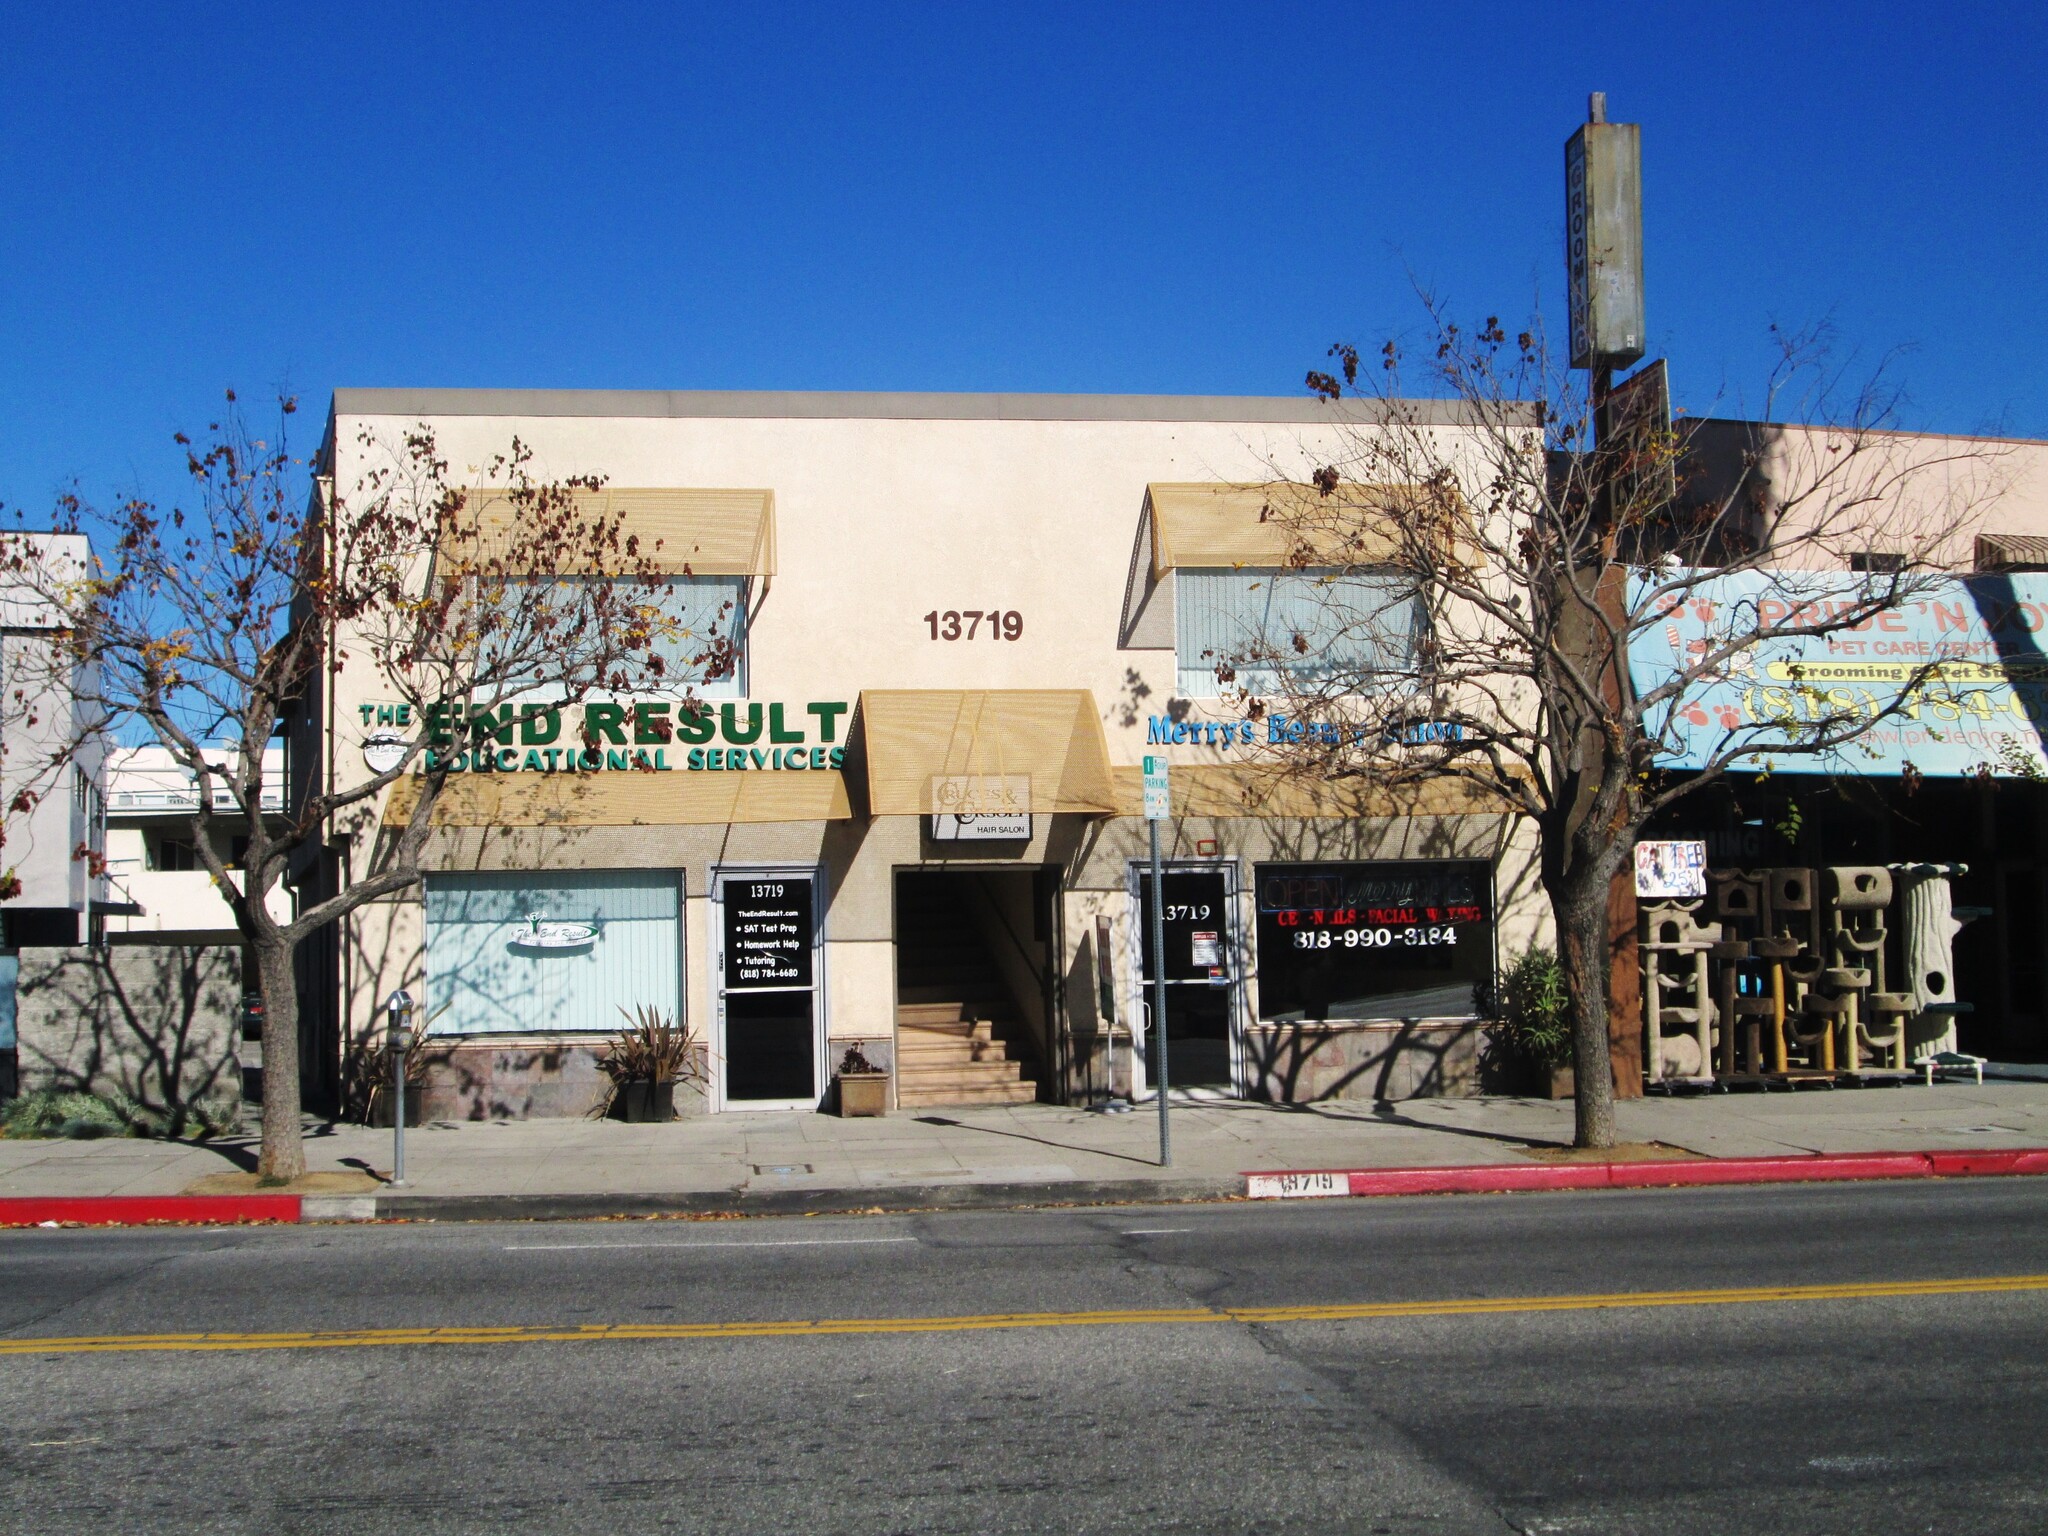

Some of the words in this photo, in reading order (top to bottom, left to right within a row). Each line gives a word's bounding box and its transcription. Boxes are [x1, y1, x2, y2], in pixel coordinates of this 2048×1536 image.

[924, 610, 1023, 641] 13719
[1828, 641, 1867, 656] PET
[1872, 641, 1931, 656] CARE
[1935, 641, 2019, 657] CENTER
[1894, 687, 2048, 722] 784-6
[359, 703, 411, 728] THE
[425, 703, 561, 747] END
[584, 702, 848, 746] RESULT
[1147, 714, 1255, 751] Merry's
[425, 747, 672, 772] EDUCATIONAL
[687, 746, 845, 771] SERVICES
[1145, 777, 1168, 790] PARKING
[977, 826, 997, 834] HAIR
[998, 825, 1025, 834] SALON
[1636, 842, 1669, 869] CAT
[751, 884, 784, 898] 13719
[738, 910, 799, 918] TheEndResult.com
[1162, 904, 1211, 921] 3719
[517, 929, 532, 938] The
[540, 928, 557, 938] End
[561, 928, 589, 938] Result
[744, 924, 759, 934] SAT
[761, 924, 778, 933] Test
[780, 923, 797, 935] Prep
[744, 940, 780, 950] Homework
[783, 939, 800, 951] Help
[1293, 926, 1458, 950] 818-990-3184
[745, 956, 776, 967] Tutoring
[740, 968, 760, 980] (818)
[762, 968, 798, 978] 784-6680
